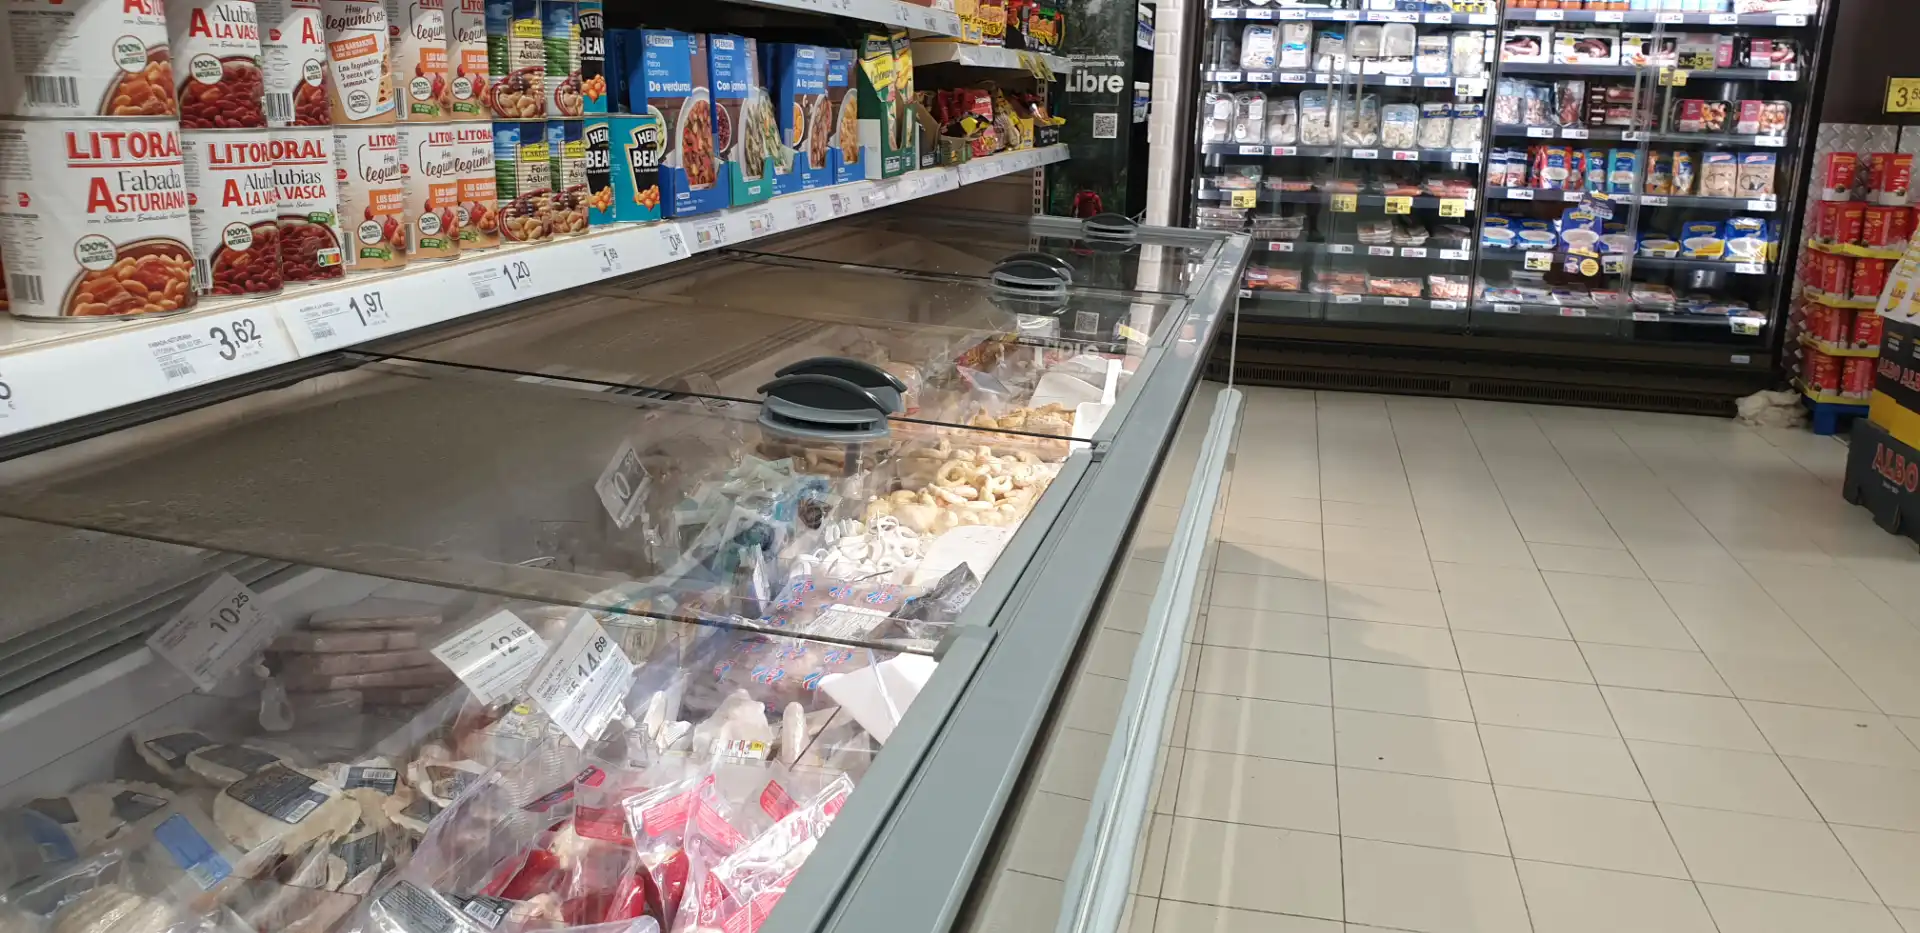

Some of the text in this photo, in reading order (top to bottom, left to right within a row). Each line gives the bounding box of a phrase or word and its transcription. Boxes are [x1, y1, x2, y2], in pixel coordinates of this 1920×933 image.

[189, 8, 212, 37] A
[215, 24, 233, 38] LA
[194, 60, 217, 68] 100%
[649, 81, 691, 92] De verduras
[1065, 70, 1124, 93] Libre
[118, 168, 182, 191] Fabada
[222, 179, 243, 207] A
[284, 185, 326, 200] VASCA
[227, 228, 247, 236] 100%
[80, 242, 109, 252] 100%
[503, 261, 530, 290] 1,20
[350, 291, 384, 327] 1,97
[210, 318, 262, 361] 3,62
[1872, 443, 1918, 492] ALBO
[210, 592, 249, 632] 10,25
[578, 636, 608, 683] 14,69
